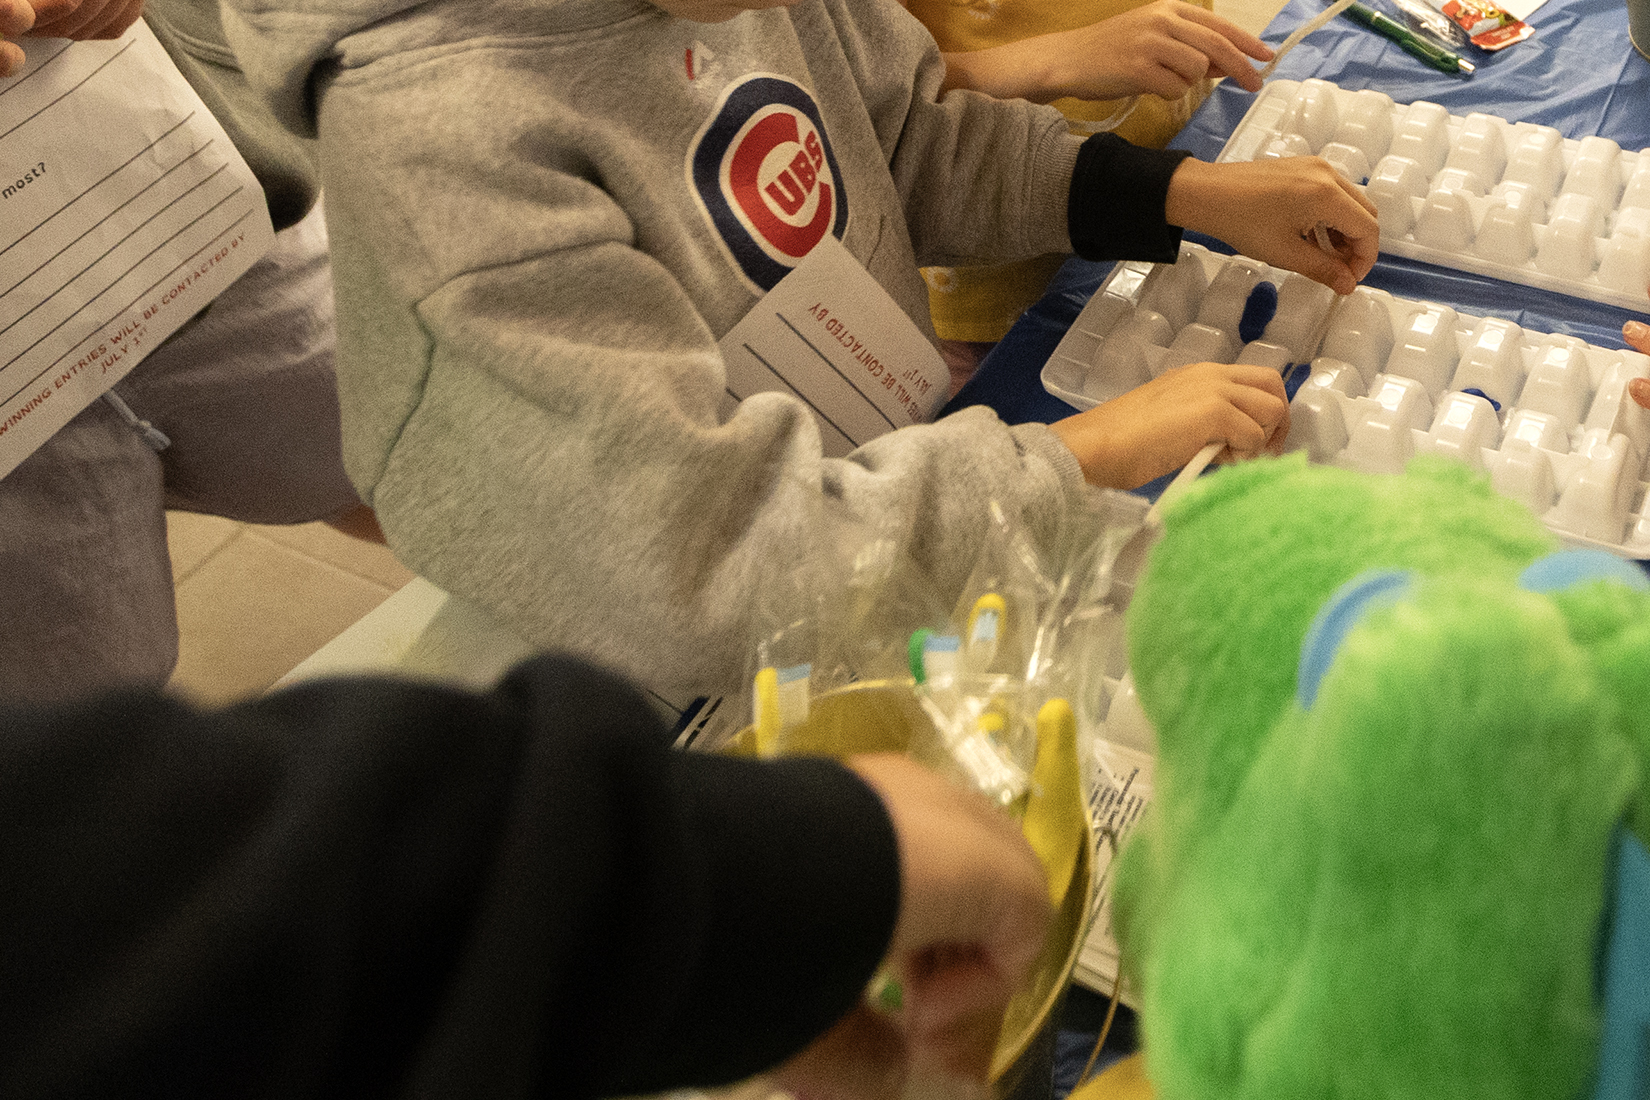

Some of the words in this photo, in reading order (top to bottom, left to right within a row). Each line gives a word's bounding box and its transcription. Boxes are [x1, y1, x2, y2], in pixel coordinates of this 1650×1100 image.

[1, 162, 46, 199] most?
[729, 112, 832, 258] CUBS
[808, 302, 829, 321] BY
[0, 387, 52, 435] WINNING
[54, 344, 107, 389] ENTRIES
[110, 320, 141, 345] WILL
[143, 304, 158, 320] BE
[162, 247, 229, 305] CONTACTED
[231, 232, 245, 247] BY
[825, 318, 885, 377] CONTACTED
[101, 344, 128, 374] JULY
[881, 372, 897, 390] BE
